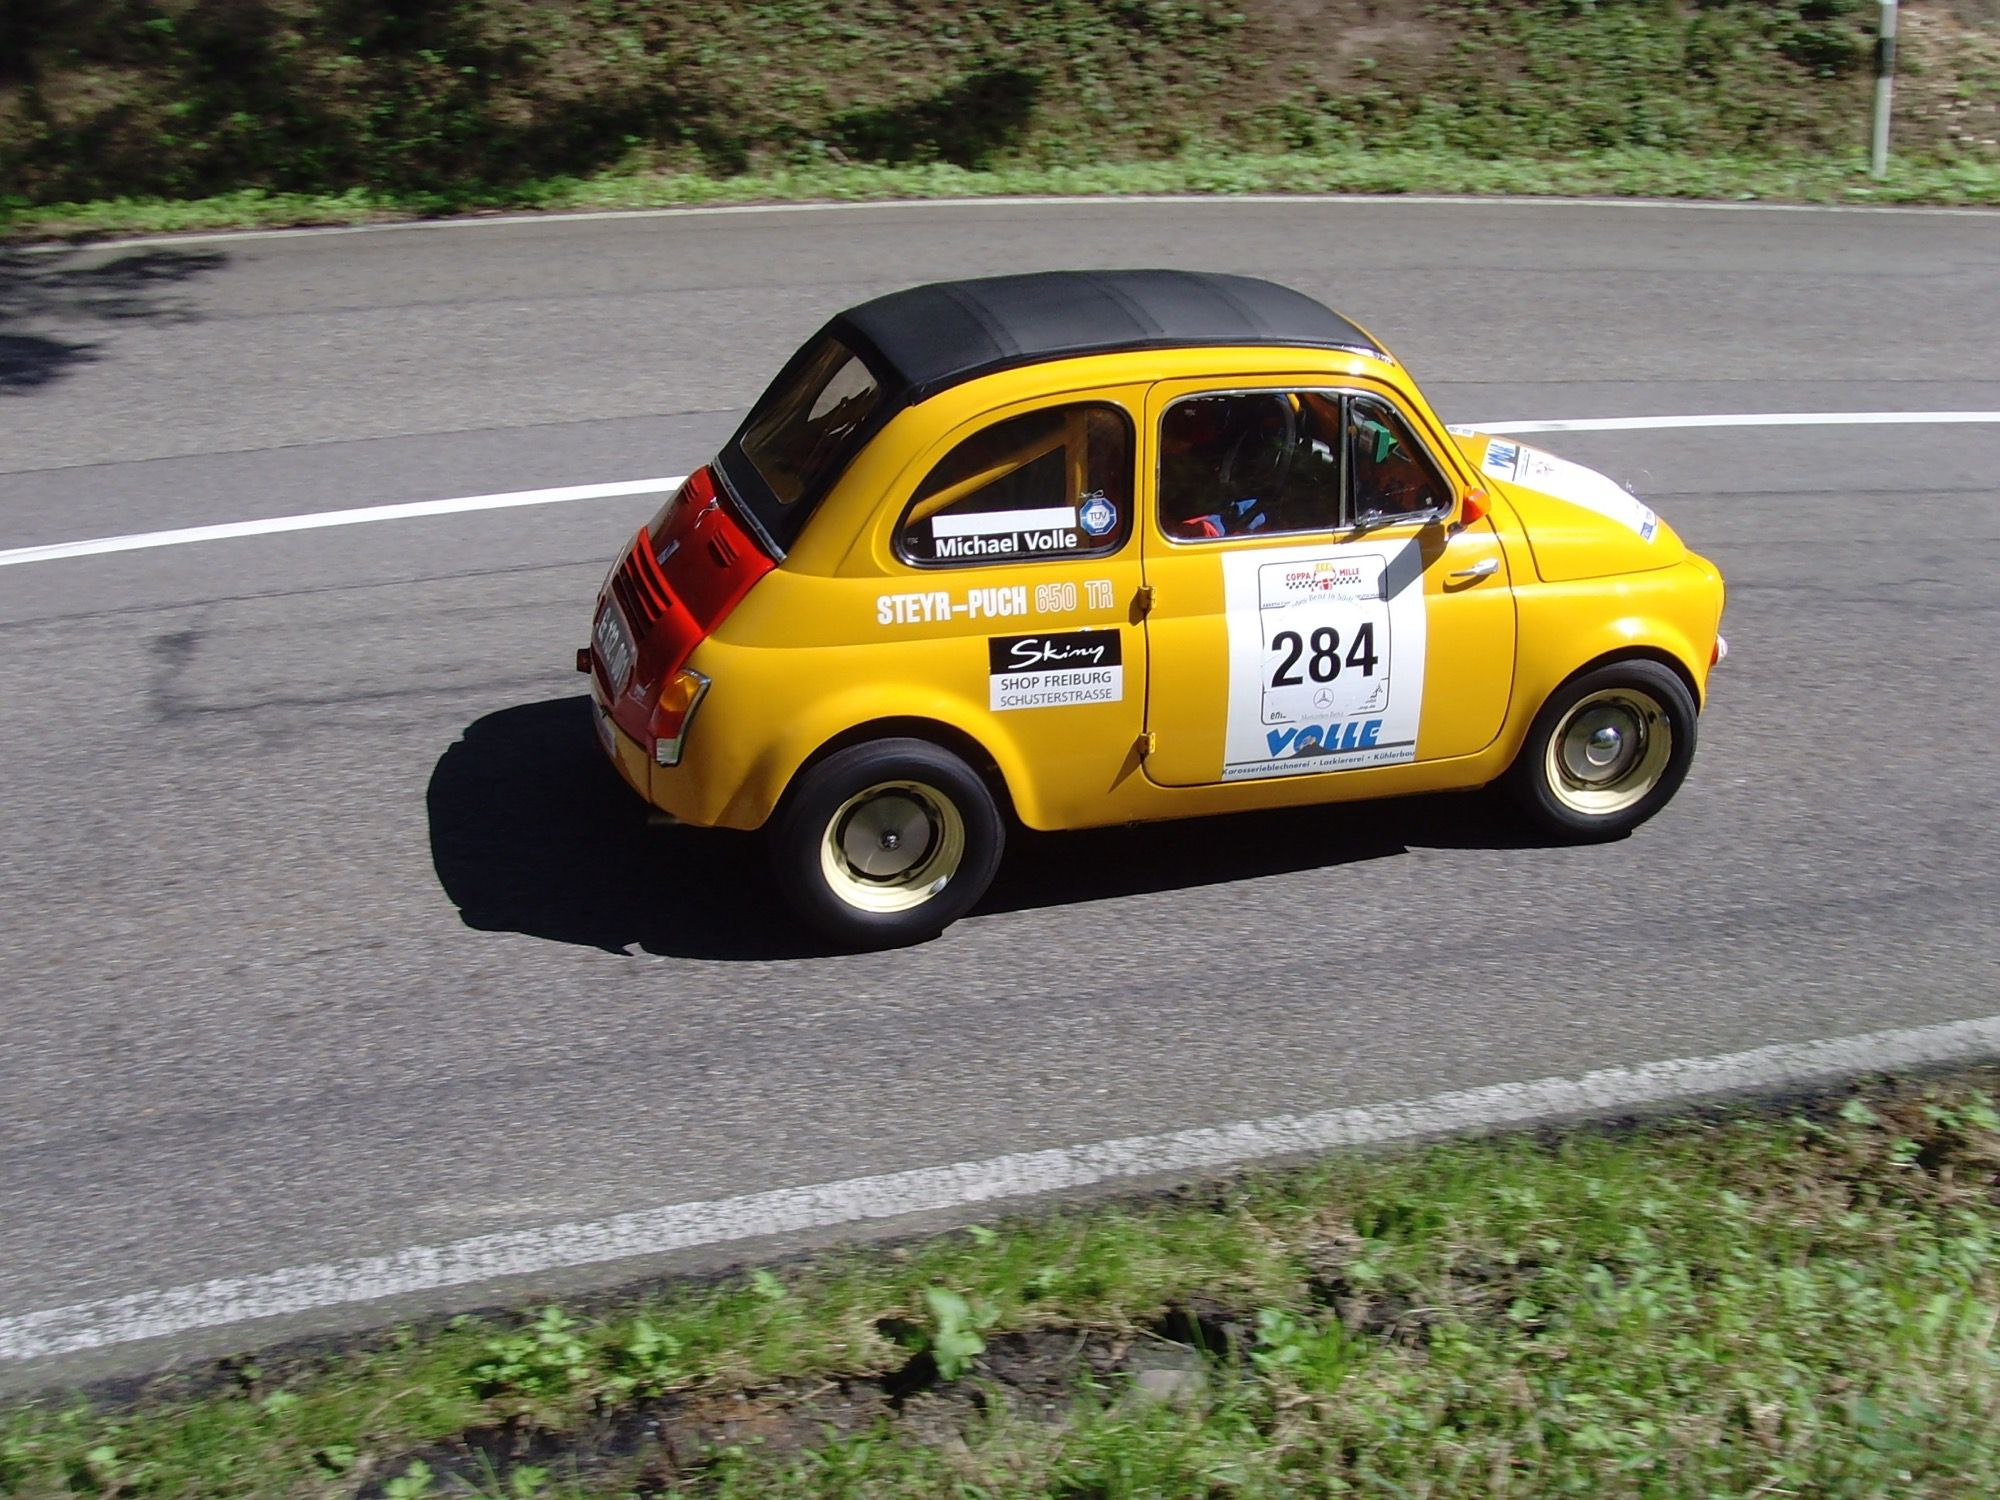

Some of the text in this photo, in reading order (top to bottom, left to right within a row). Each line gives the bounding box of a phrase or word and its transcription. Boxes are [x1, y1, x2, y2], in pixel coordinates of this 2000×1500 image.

[935, 529, 1078, 558] Michael Volle
[1286, 567, 1361, 582] COPPA MILLE
[876, 579, 1114, 625] STEYR-PUCH 650 TR
[1007, 638, 1105, 670] Skiny
[1271, 622, 1379, 688] 284
[1000, 671, 1112, 691] SHOP FREIBURG
[1000, 688, 1113, 707] SCHUSTERSTRASSE
[1266, 719, 1383, 758] VOLLE
[1222, 748, 1416, 776] Karosserieblechnerei Lackiererei Kühlerbau
